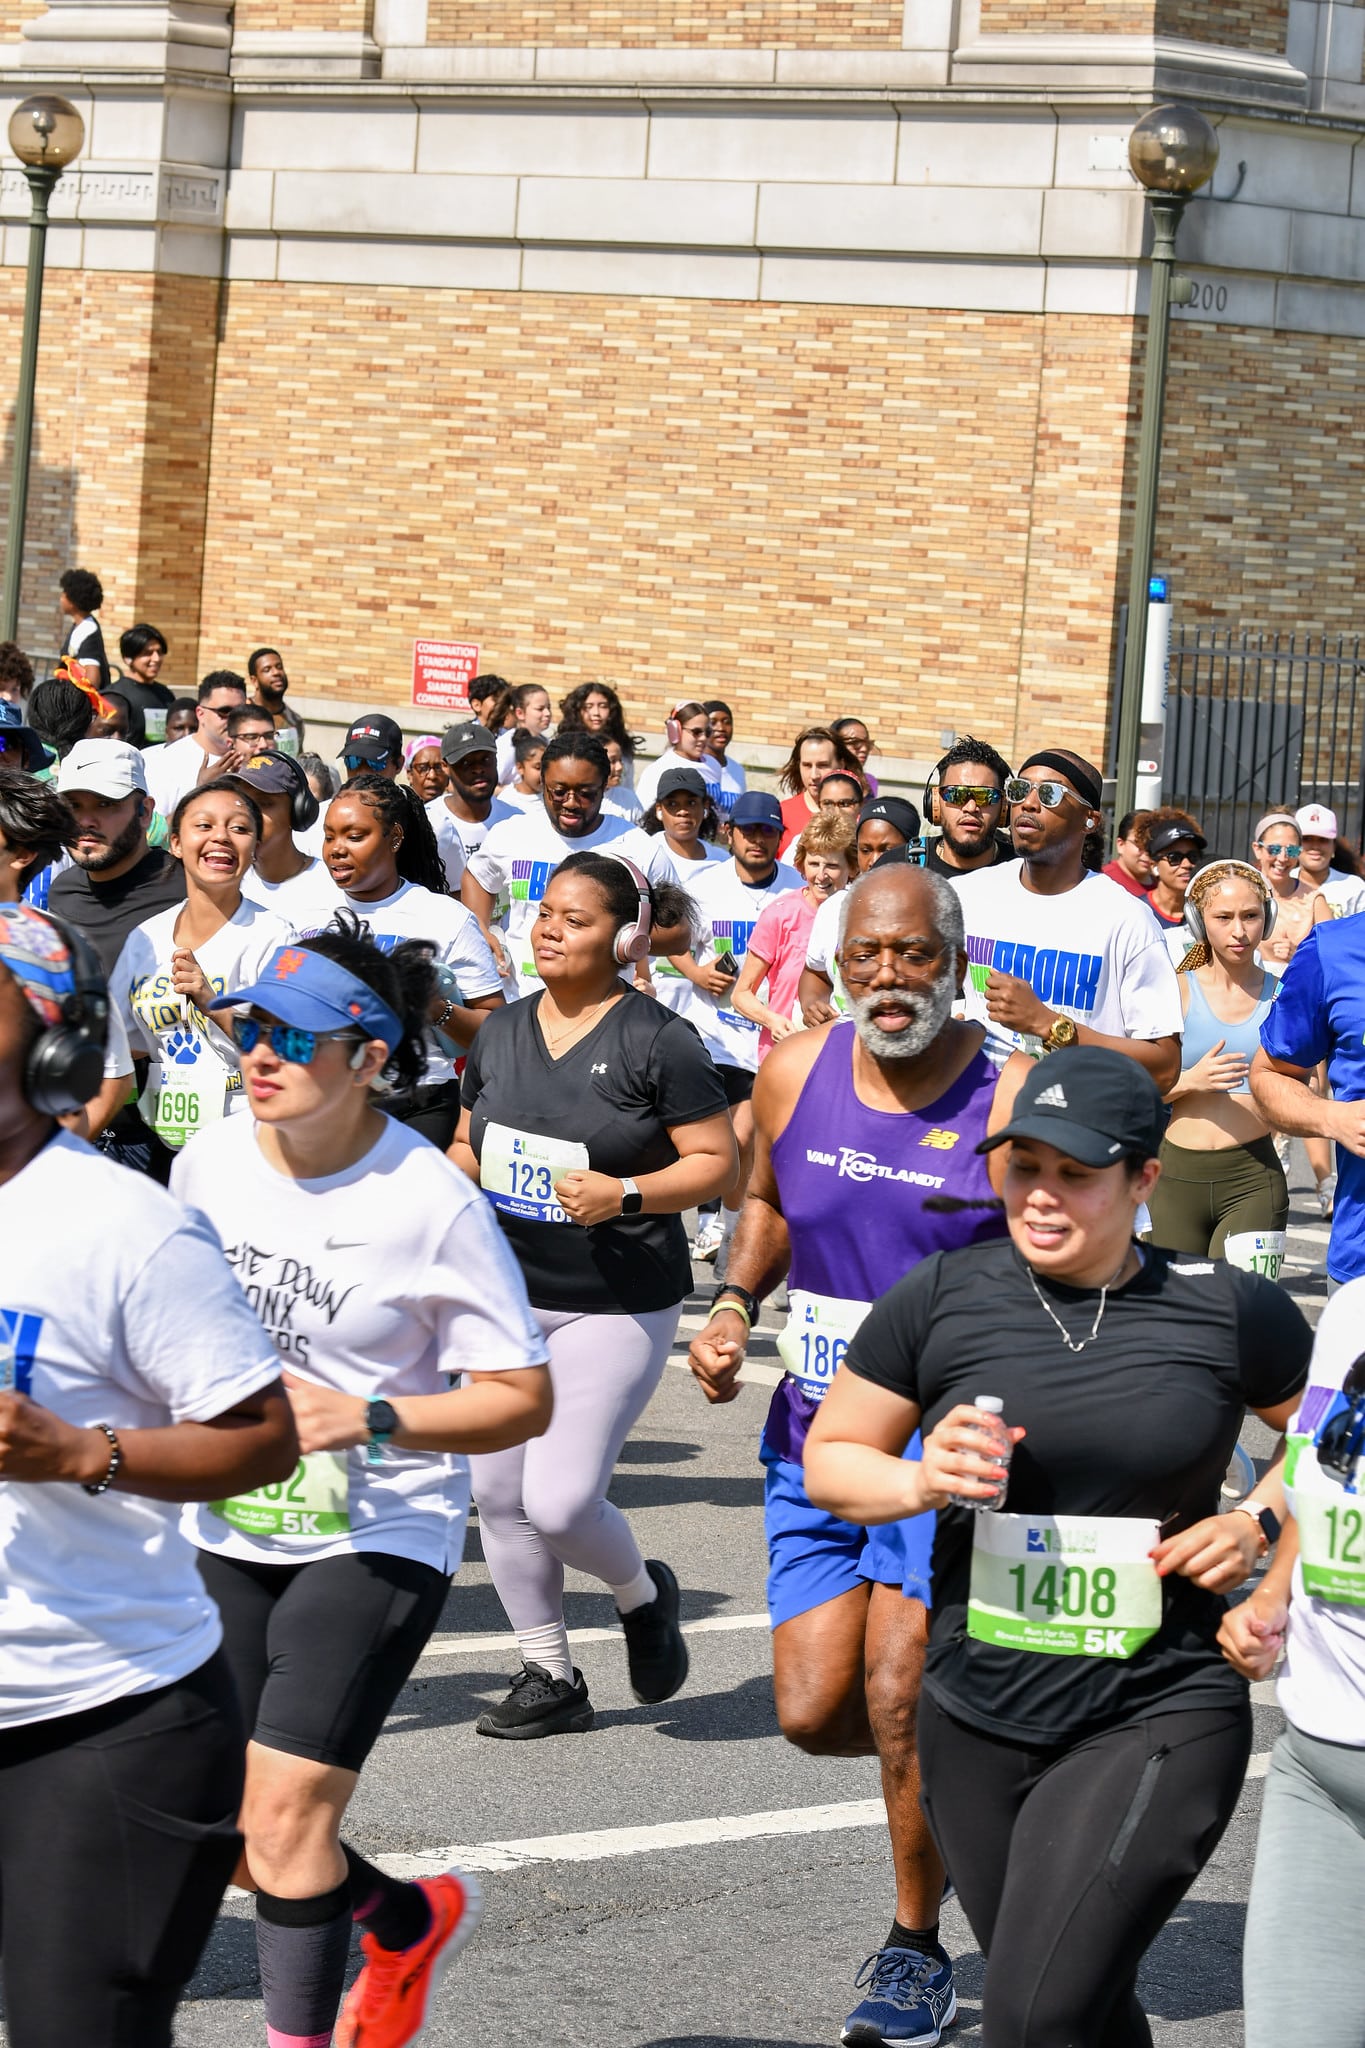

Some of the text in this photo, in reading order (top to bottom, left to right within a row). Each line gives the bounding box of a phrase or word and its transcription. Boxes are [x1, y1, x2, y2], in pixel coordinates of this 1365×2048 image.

[416, 642, 478, 659] COMBINATION
[417, 655, 464, 670] STANDPIPE
[422, 668, 469, 683] SPRINKLER
[426, 681, 463, 695] SIAMESE
[966, 934, 995, 966] RUN
[992, 940, 1103, 1012] BRONX
[155, 1091, 200, 1123] 1696
[806, 1149, 837, 1167] VAN
[508, 1160, 552, 1201] 123
[282, 1511, 322, 1534] 5K
[1008, 1563, 1117, 1619] 1408
[1082, 1628, 1129, 1656] 5K
